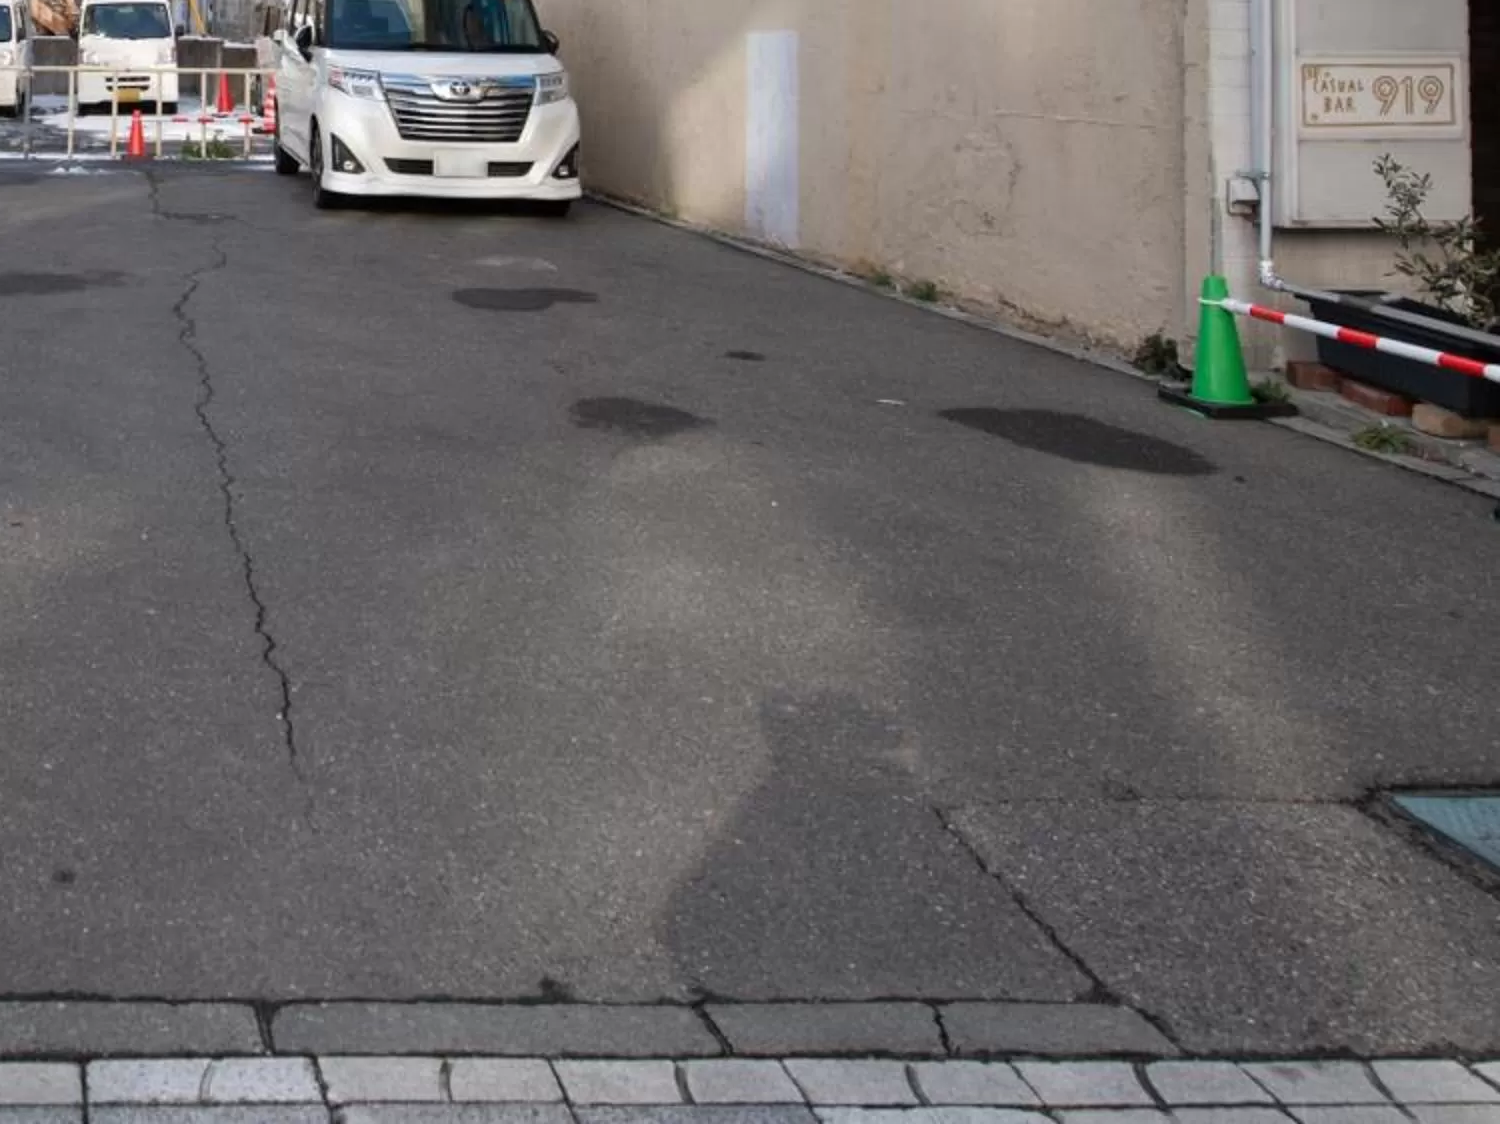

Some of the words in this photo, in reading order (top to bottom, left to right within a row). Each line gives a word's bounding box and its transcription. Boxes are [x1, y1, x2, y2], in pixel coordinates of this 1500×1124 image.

[1312, 76, 1365, 93] CASUAL
[1372, 75, 1445, 117] 919
[1323, 95, 1356, 114] BAR
